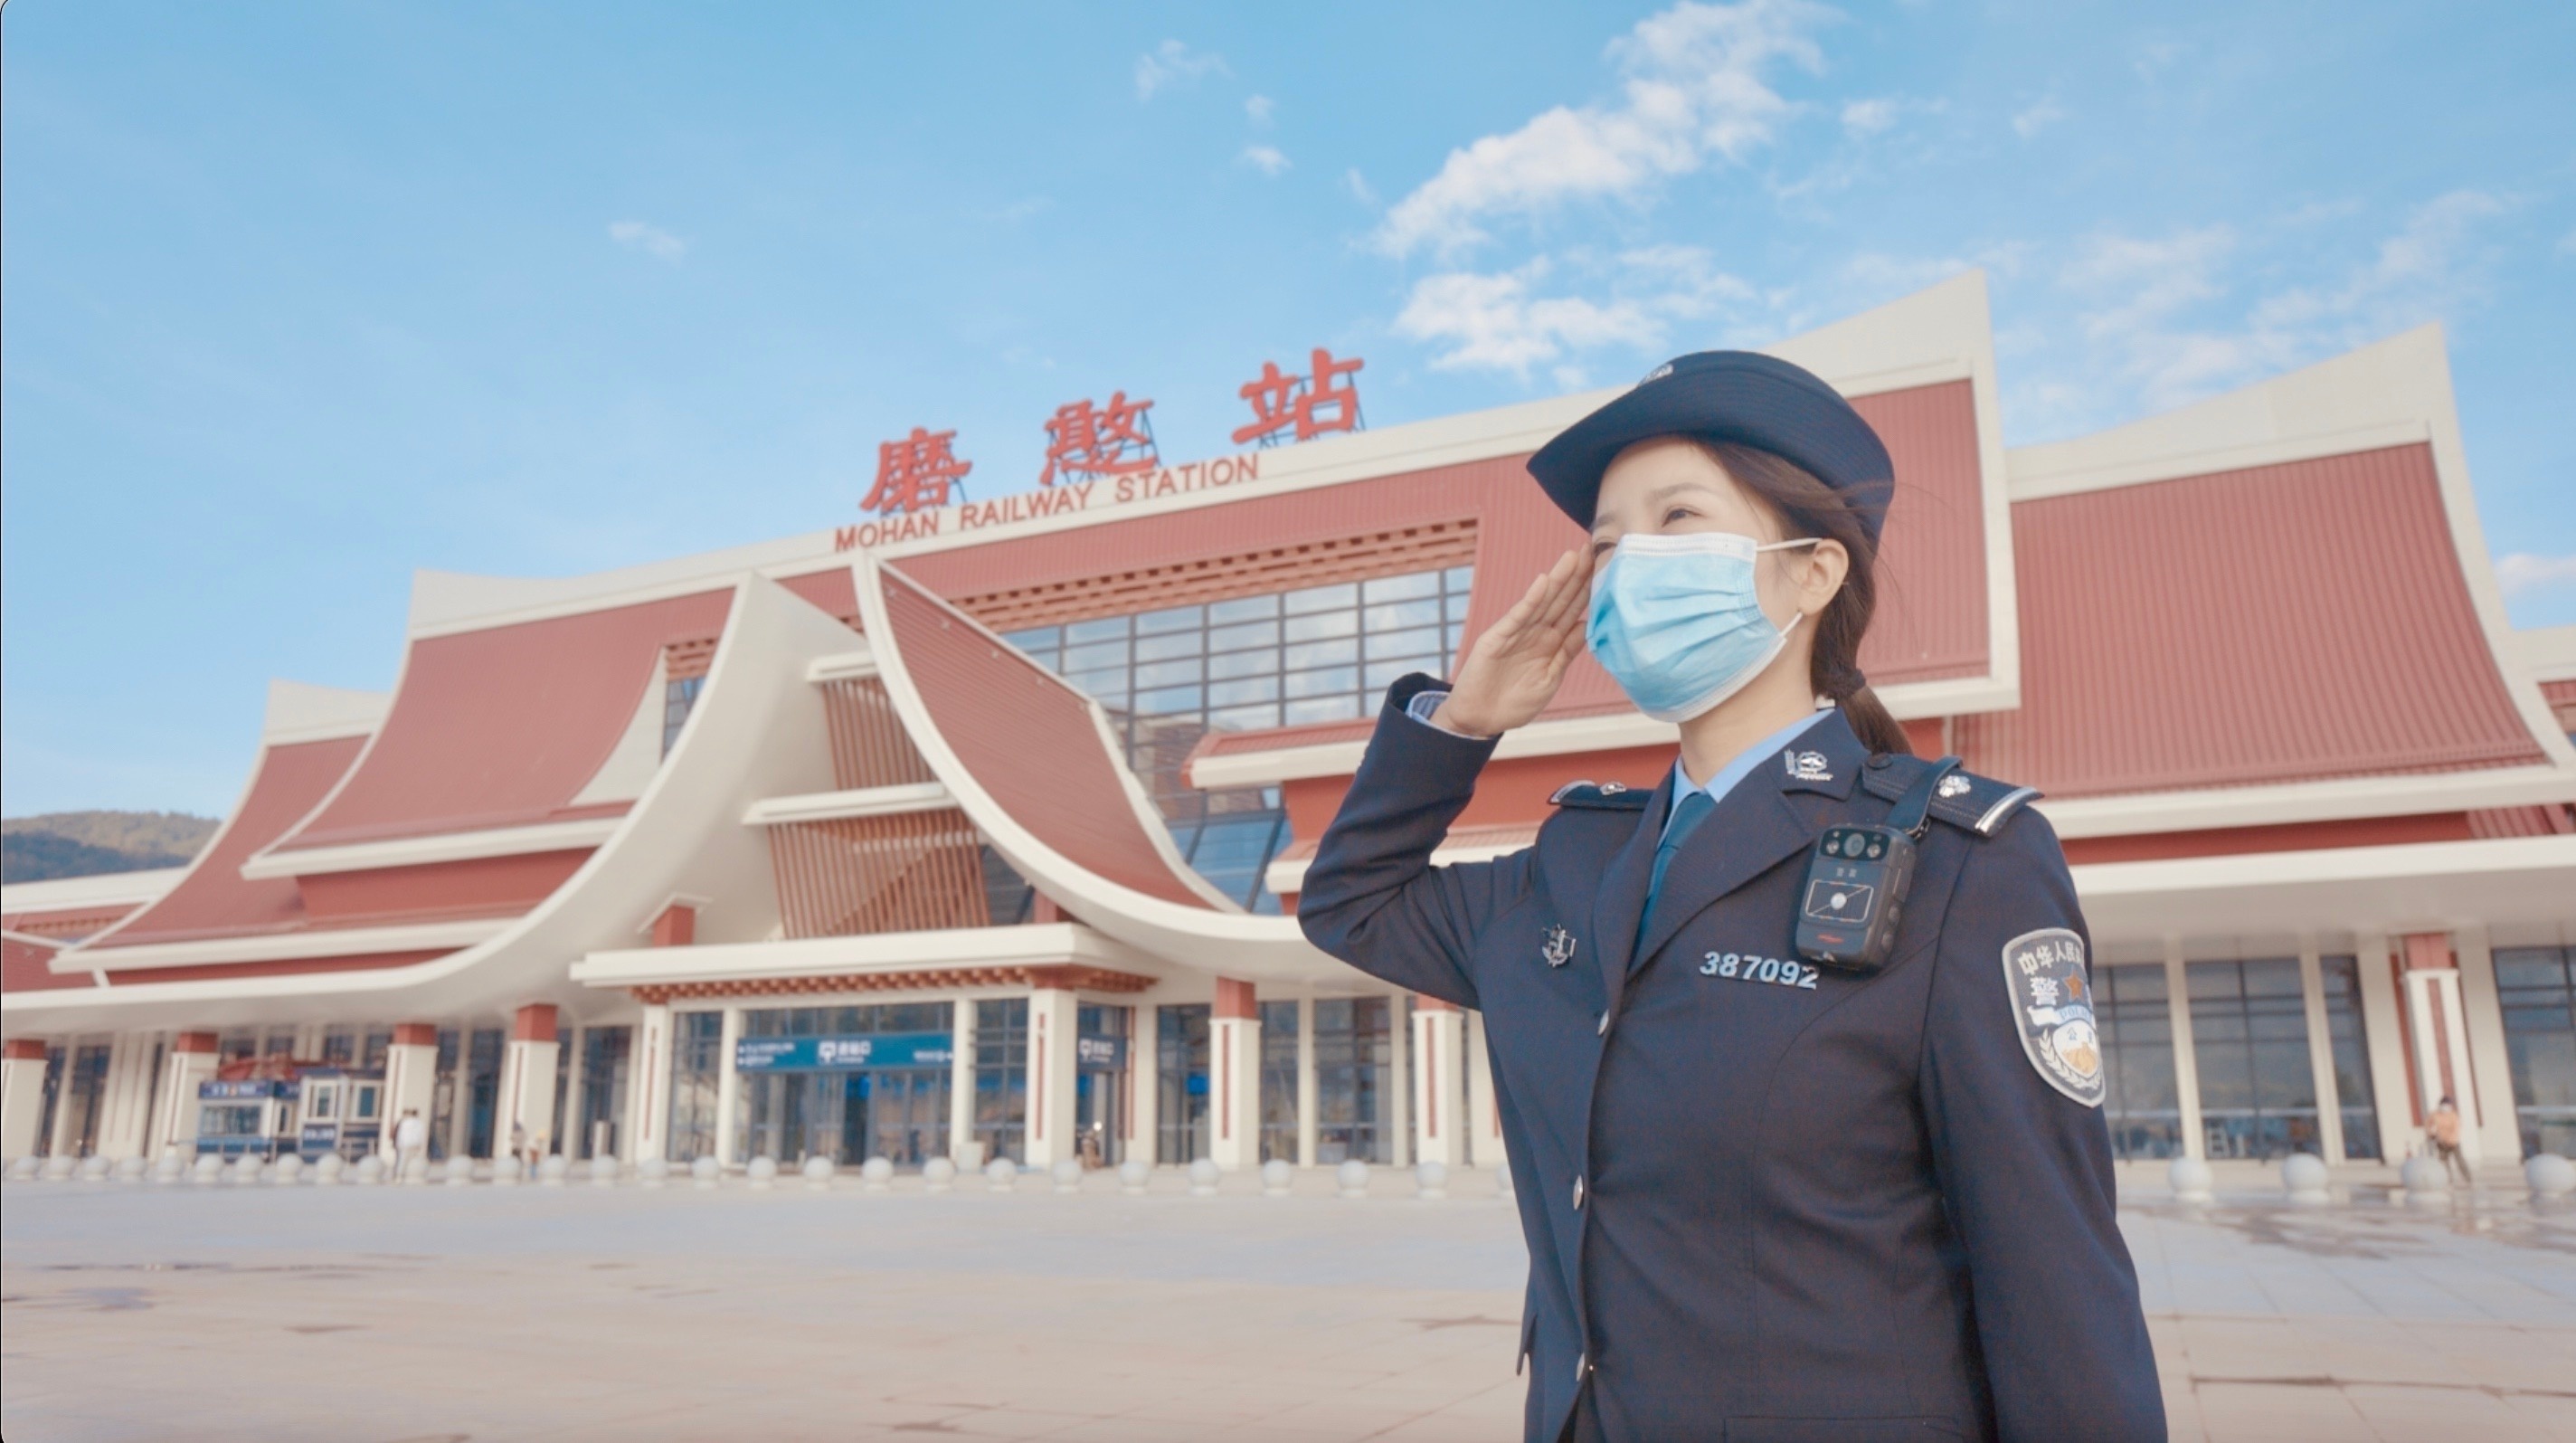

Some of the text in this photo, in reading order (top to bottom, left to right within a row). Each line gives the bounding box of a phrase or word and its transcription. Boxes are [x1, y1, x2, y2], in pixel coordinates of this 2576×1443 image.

[859, 348, 1364, 513] 磨憨站
[836, 454, 1258, 551] MOHAN RAILWAY STATION
[1700, 951, 1818, 990] 387092
